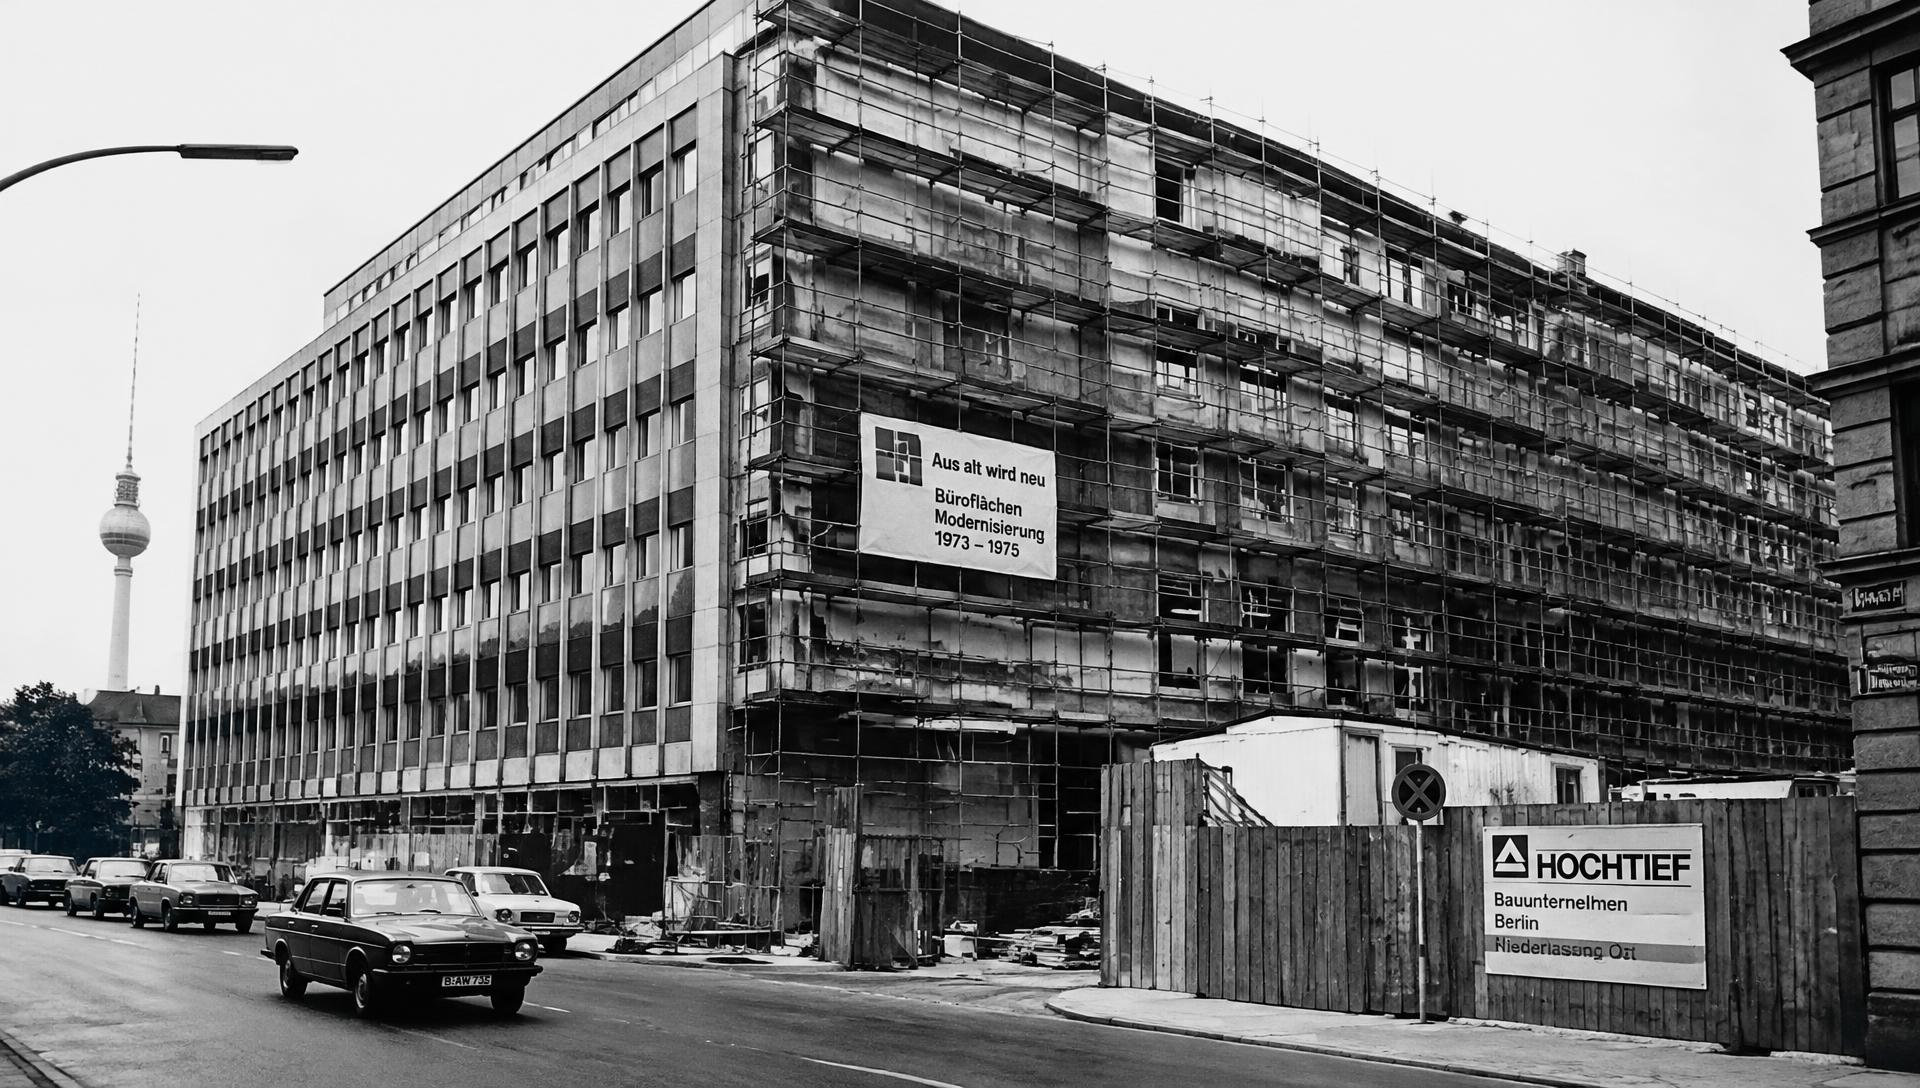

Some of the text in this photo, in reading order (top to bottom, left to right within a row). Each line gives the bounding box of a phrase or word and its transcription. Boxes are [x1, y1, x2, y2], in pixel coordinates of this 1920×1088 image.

[932, 452, 1046, 487] Aus alt wird neu
[935, 508, 1045, 544] Modernisierung
[935, 530, 970, 551] 1973
[988, 539, 1020, 558] 1975
[1537, 853, 1691, 881] HOCHTIEF
[1495, 913, 1539, 931] Berlin
